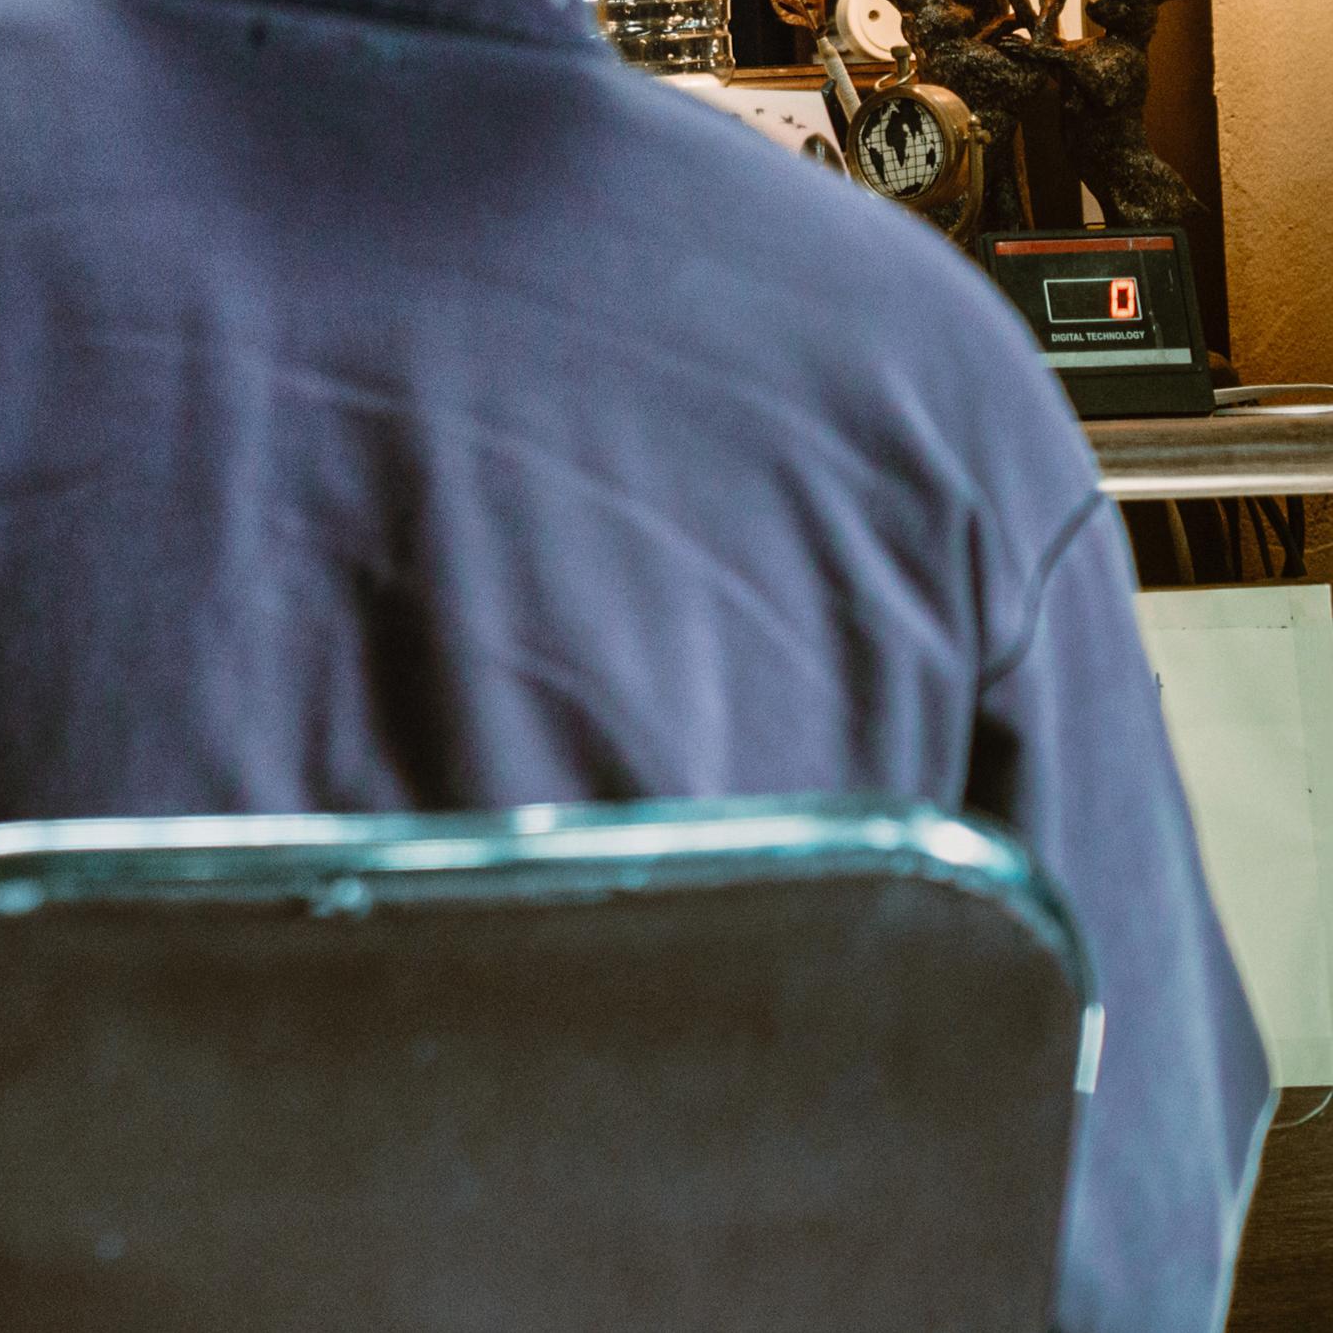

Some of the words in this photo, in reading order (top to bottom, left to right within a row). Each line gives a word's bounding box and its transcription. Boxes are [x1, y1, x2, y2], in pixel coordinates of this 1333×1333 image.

[1110, 278, 1136, 319] 0
[1051, 332, 1084, 343] DIGITAL
[1086, 331, 1145, 342] TECHNOLOGY
